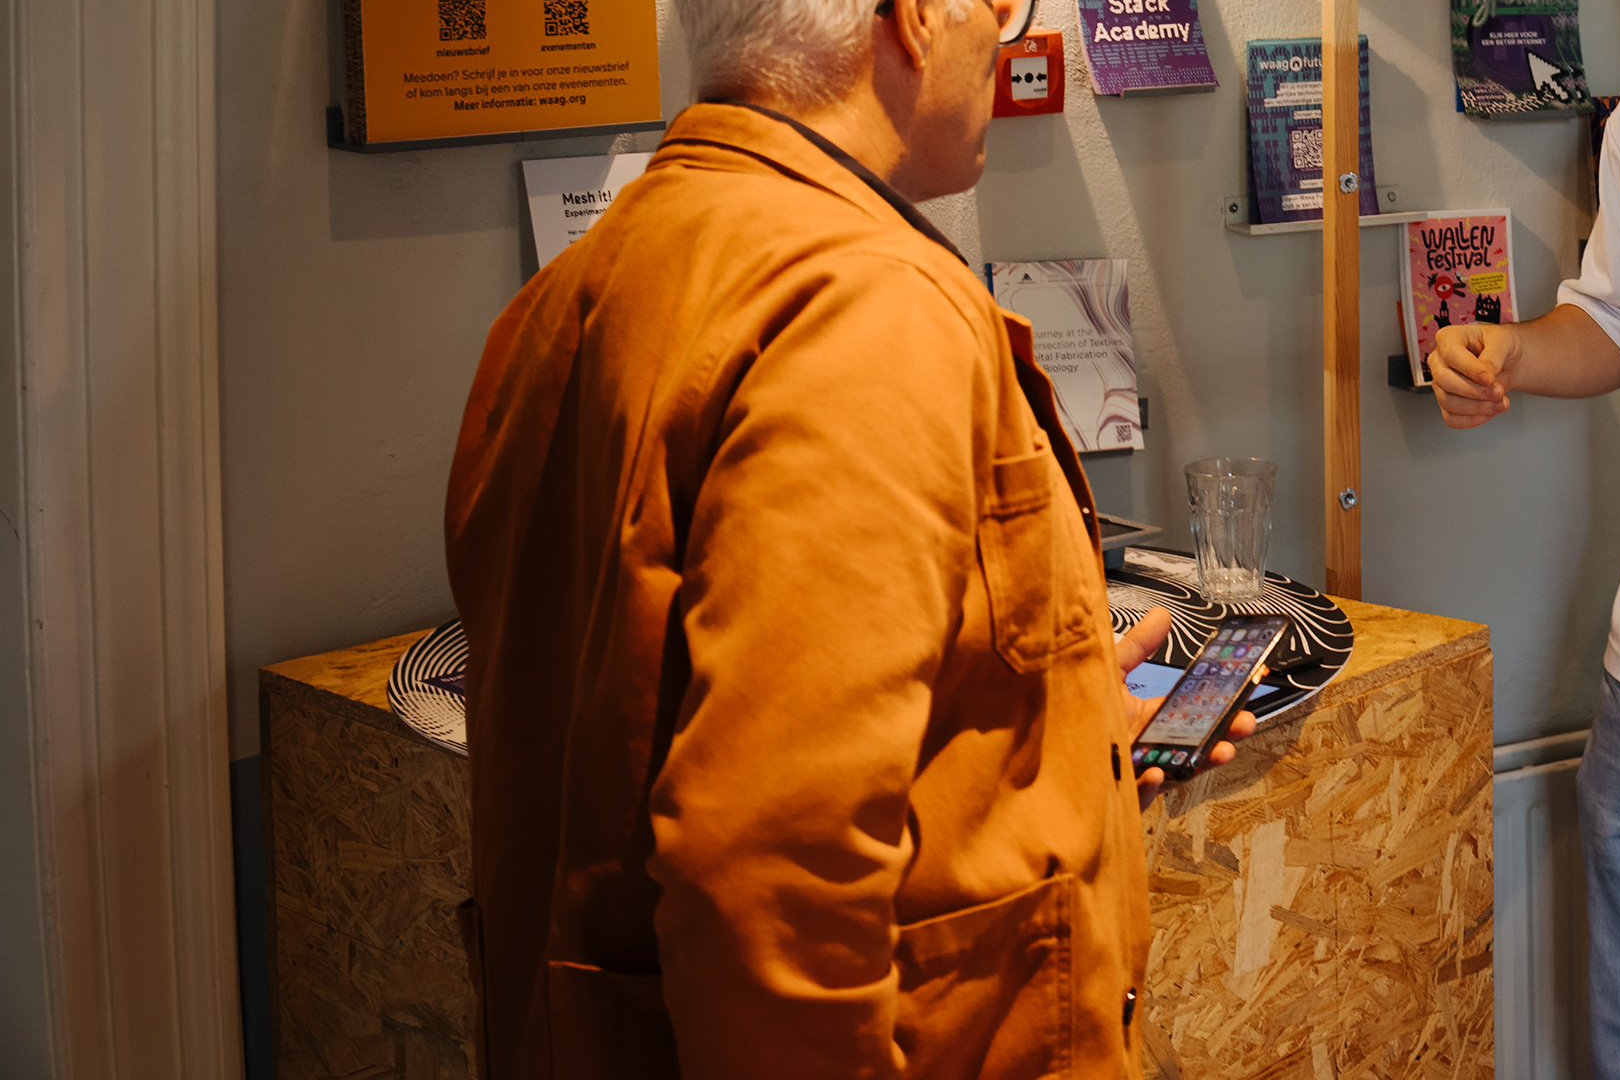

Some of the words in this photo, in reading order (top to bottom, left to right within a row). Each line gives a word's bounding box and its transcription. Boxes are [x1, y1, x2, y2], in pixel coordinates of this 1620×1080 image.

[1093, 20, 1190, 43] Academy
[436, 46, 490, 57] nieuwsbrief
[541, 42, 596, 52] evenementen
[1260, 58, 1288, 71] waag
[403, 70, 459, 83] Meedoen?
[462, 69, 495, 80] Schrijf
[497, 70, 507, 80] je
[509, 68, 519, 77] in
[521, 68, 544, 76] voor
[546, 66, 571, 75] onze
[573, 61, 629, 74] nieuwsbrief
[406, 88, 417, 98] of
[419, 88, 443, 97] kom
[444, 86, 473, 97] langs
[475, 84, 489, 96] bij
[491, 84, 510, 93] een
[513, 84, 530, 92] van
[532, 83, 557, 91] onze
[559, 77, 628, 89] evenementen.
[454, 101, 479, 111] Meer
[481, 97, 537, 109] informatie:
[539, 95, 586, 106] waag.org
[562, 191, 596, 205] Mesh
[598, 190, 613, 203] it!
[1421, 221, 1495, 251] WALLEN
[1066, 329, 1075, 337] at
[1077, 328, 1094, 337] the
[1078, 340, 1087, 348] of
[1089, 339, 1125, 348] Textiles
[1055, 350, 1108, 360] Fabrication
[1043, 363, 1079, 374] Biology
